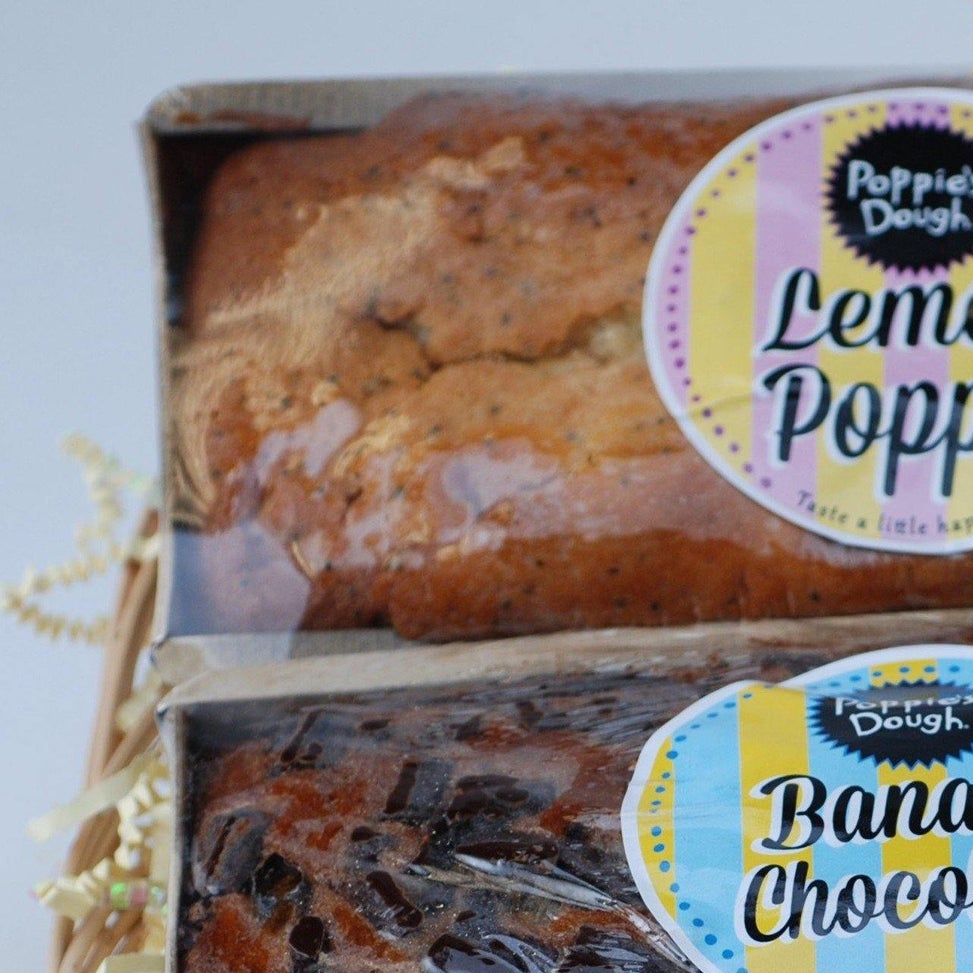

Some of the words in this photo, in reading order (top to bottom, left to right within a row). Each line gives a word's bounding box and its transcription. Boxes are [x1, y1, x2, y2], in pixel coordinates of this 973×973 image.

[798, 489, 847, 524] Taste
[856, 517, 868, 528] a
[877, 511, 927, 536] little
[849, 706, 963, 737] Dough
